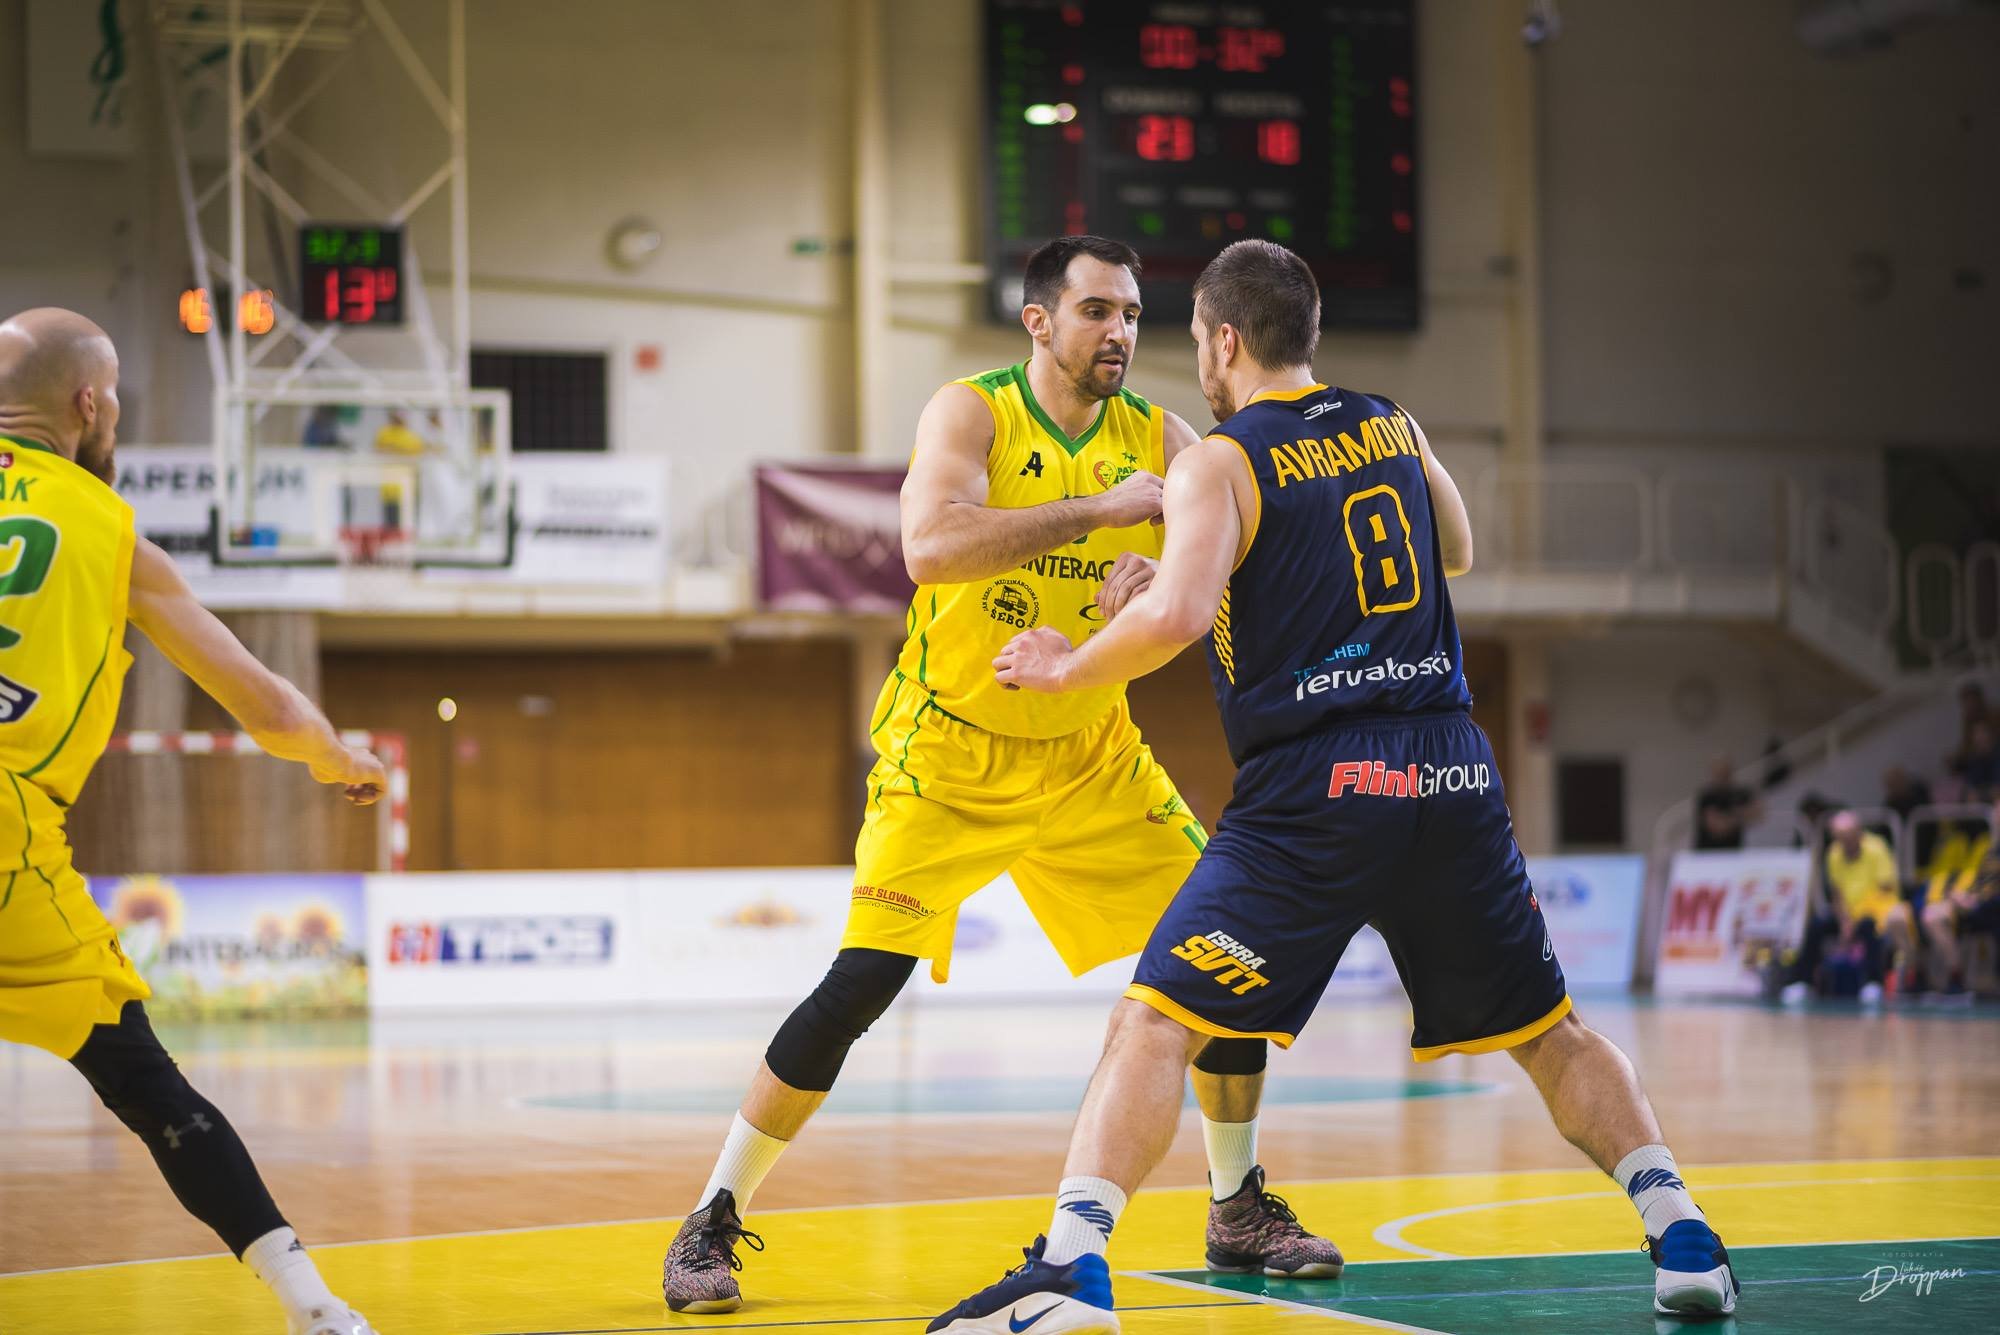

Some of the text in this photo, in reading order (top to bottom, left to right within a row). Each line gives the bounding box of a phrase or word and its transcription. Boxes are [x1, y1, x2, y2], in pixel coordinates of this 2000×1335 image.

[1343, 484, 1421, 617] 8
[990, 606, 1026, 629] ŠEBO
[876, 888, 921, 910] SLOVAKIA
[1170, 935, 1271, 996] SVIT
[1205, 929, 1267, 970] ISKRA
